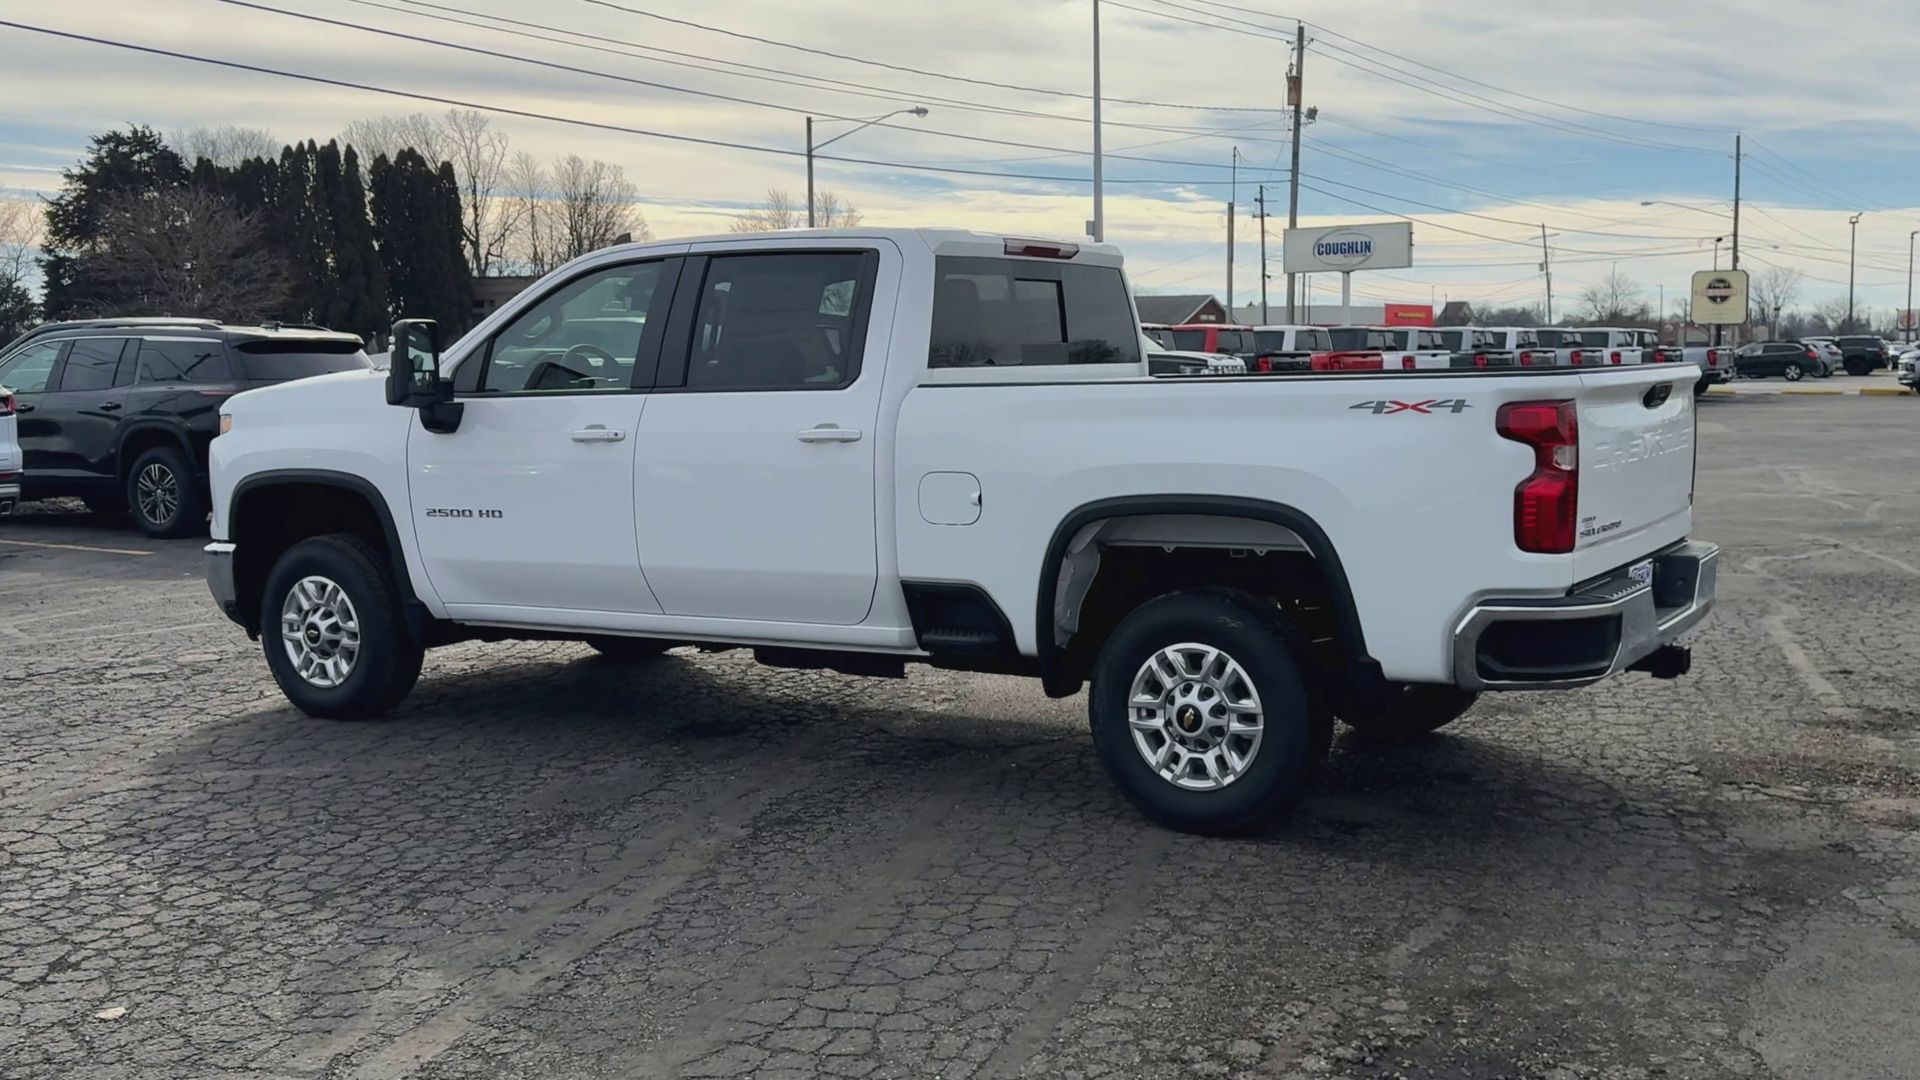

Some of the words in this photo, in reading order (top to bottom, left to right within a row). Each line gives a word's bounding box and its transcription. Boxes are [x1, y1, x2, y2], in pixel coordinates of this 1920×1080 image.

[1317, 240, 1372, 256] COUGHLIN
[424, 508, 474, 518] 2500
[478, 509, 504, 519] HD
